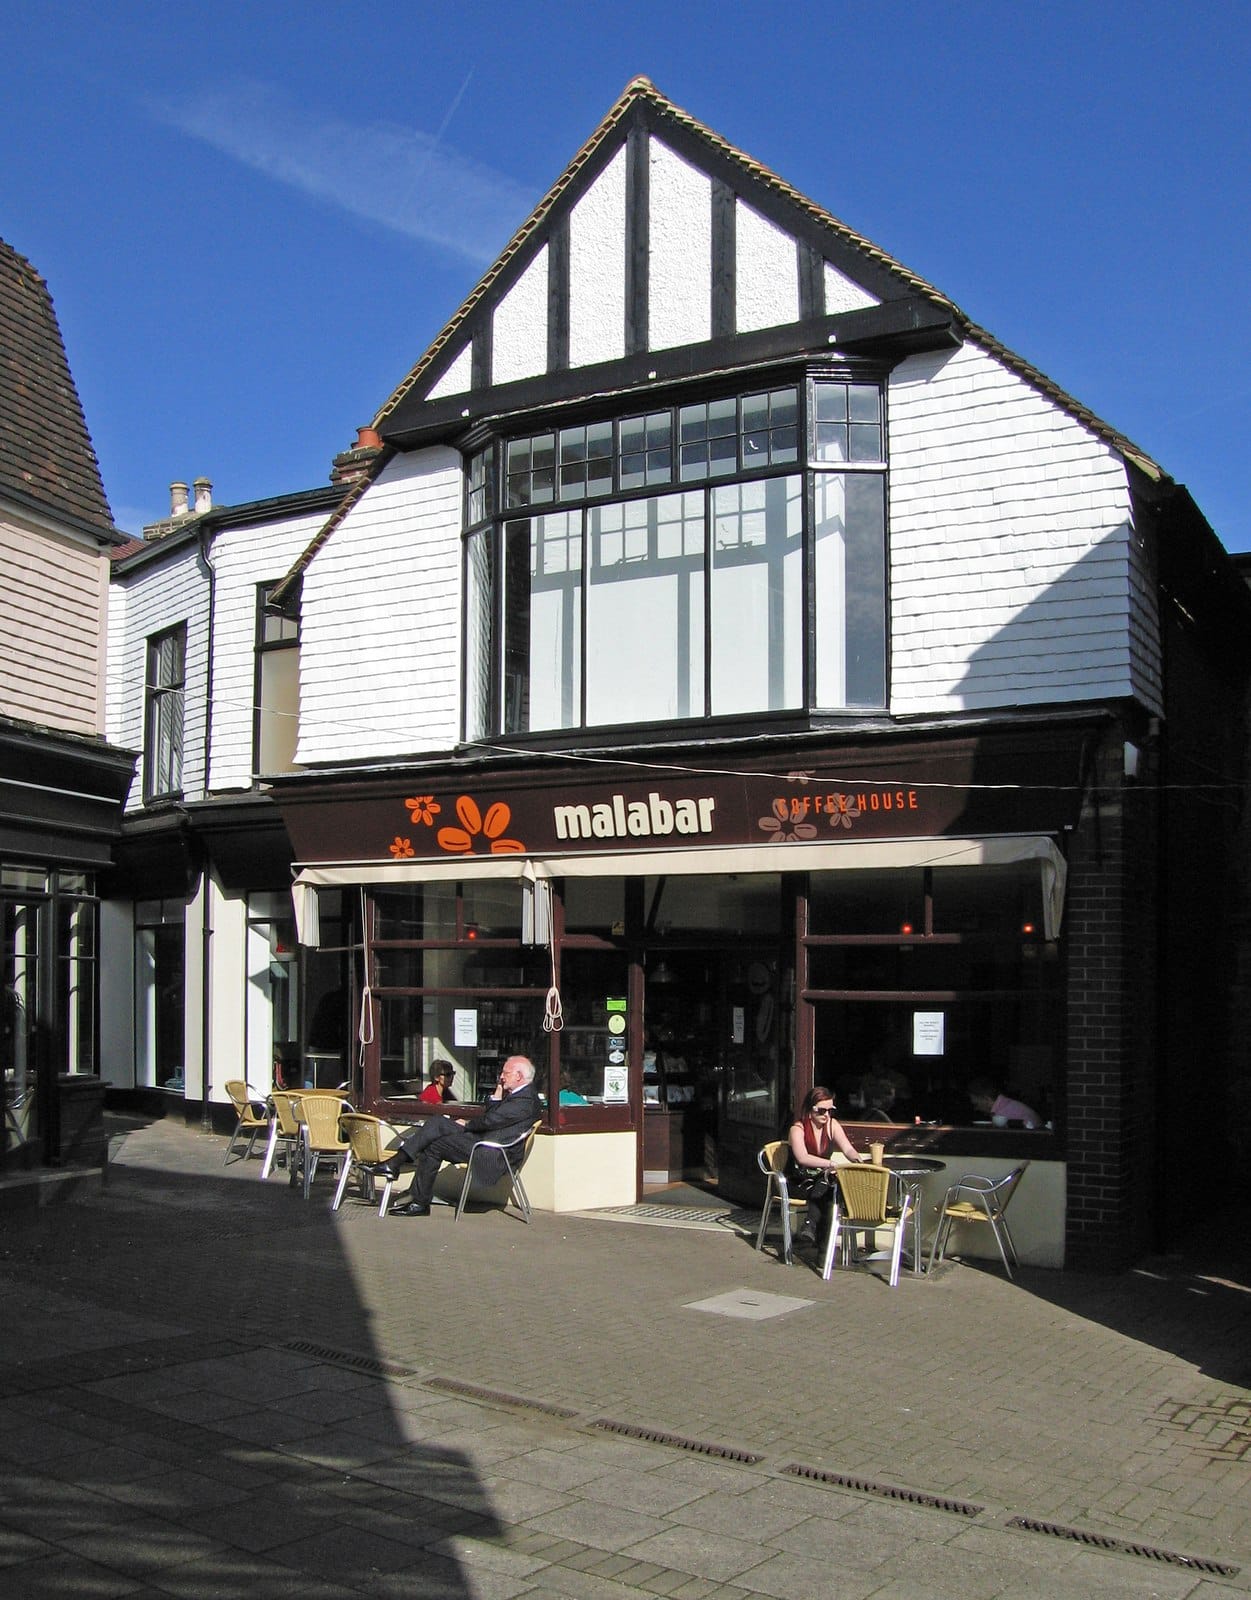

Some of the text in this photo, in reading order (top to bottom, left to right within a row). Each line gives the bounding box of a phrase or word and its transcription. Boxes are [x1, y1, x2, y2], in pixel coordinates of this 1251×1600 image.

[554, 793, 715, 839] malabar
[778, 791, 918, 815] COFFEE HOUSE
